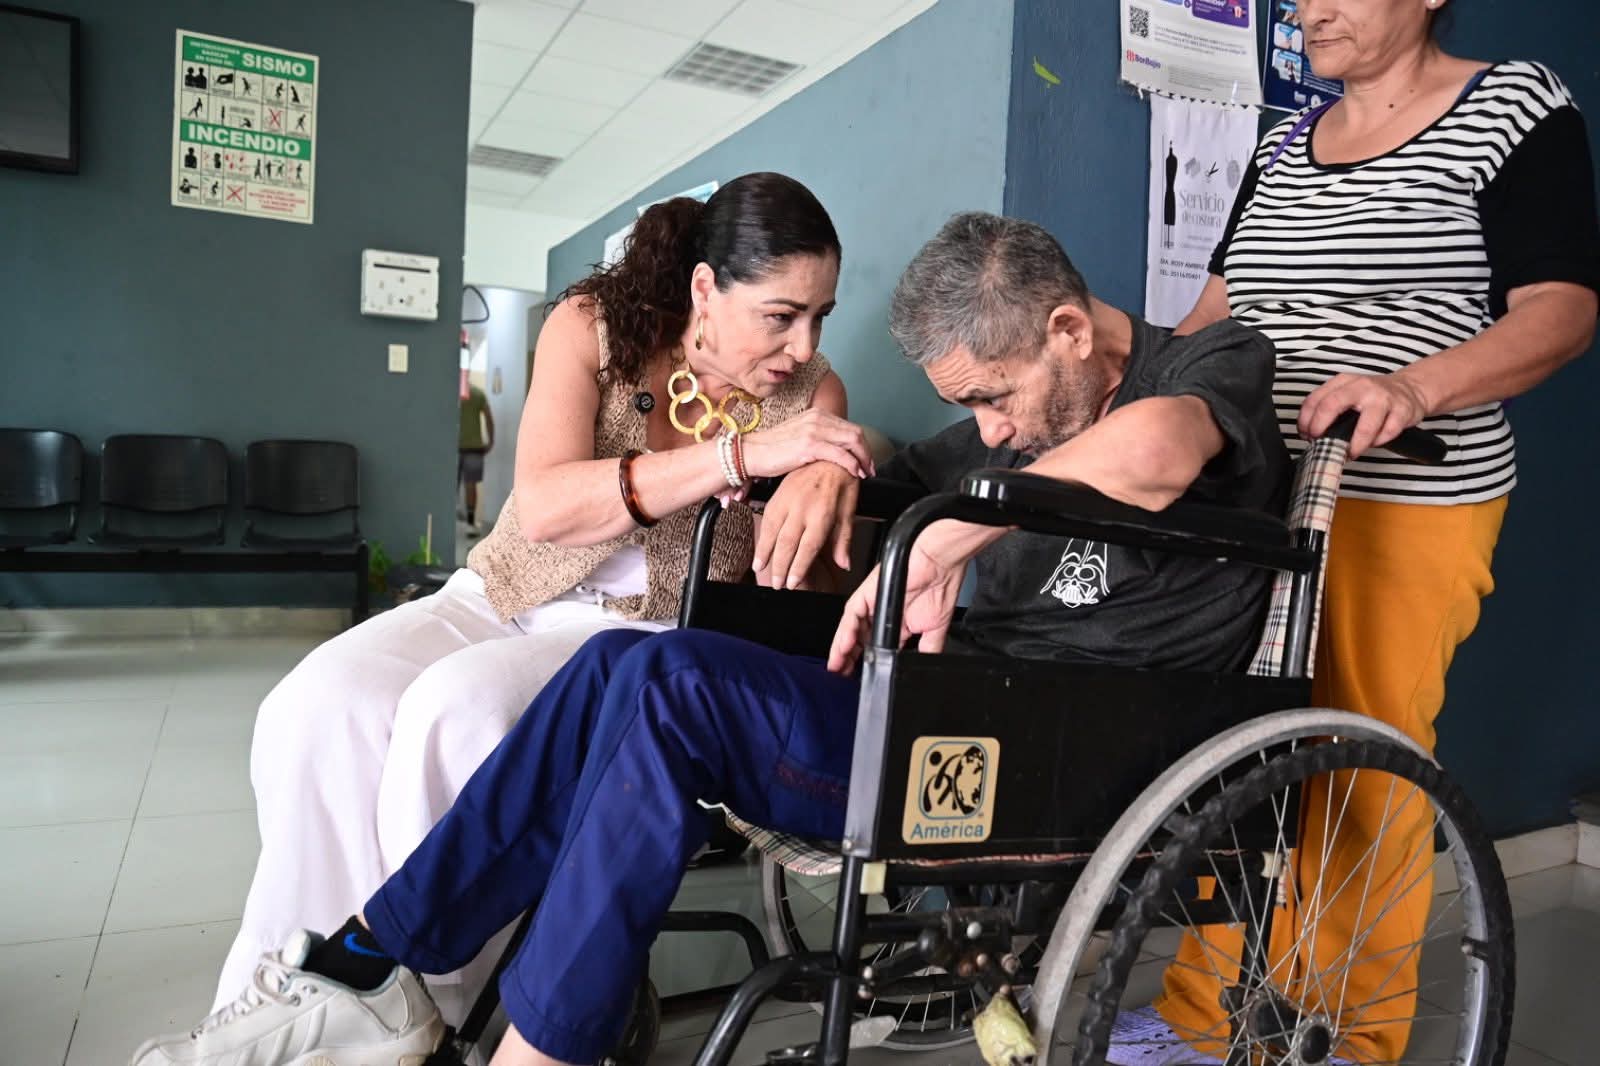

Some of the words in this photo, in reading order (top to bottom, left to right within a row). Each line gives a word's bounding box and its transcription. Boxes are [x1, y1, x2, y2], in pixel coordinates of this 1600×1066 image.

[242, 52, 306, 77] SISMO
[188, 123, 300, 156] INCENDIO
[1179, 191, 1225, 213] Servicio
[910, 821, 984, 839] América
